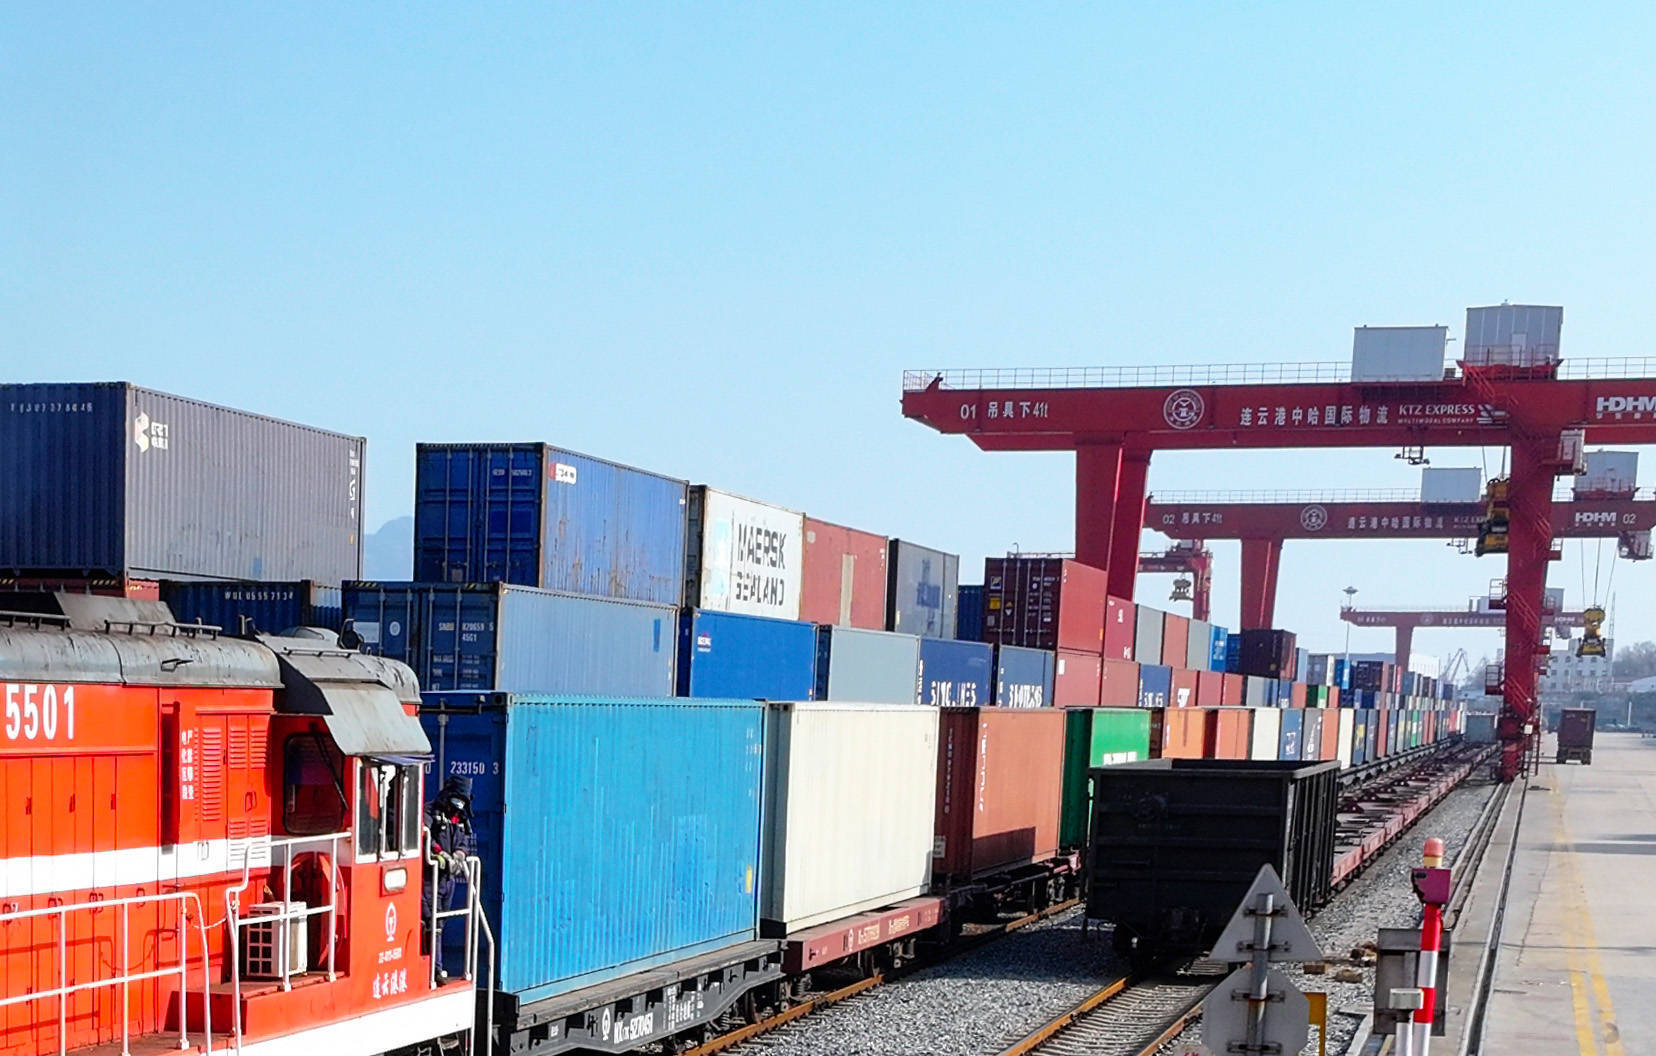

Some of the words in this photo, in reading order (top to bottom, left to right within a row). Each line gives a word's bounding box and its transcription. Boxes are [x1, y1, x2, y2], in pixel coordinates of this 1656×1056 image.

[960, 404, 976, 419] 01
[1240, 405, 1389, 426] 连云港中哈国际物流
[1399, 404, 1422, 415] KTZ
[1425, 404, 1475, 414] EXPRESS
[738, 523, 787, 570] MAERSK
[6, 684, 74, 740] 5501
[450, 761, 485, 775] 233150
[493, 762, 499, 775] 3
